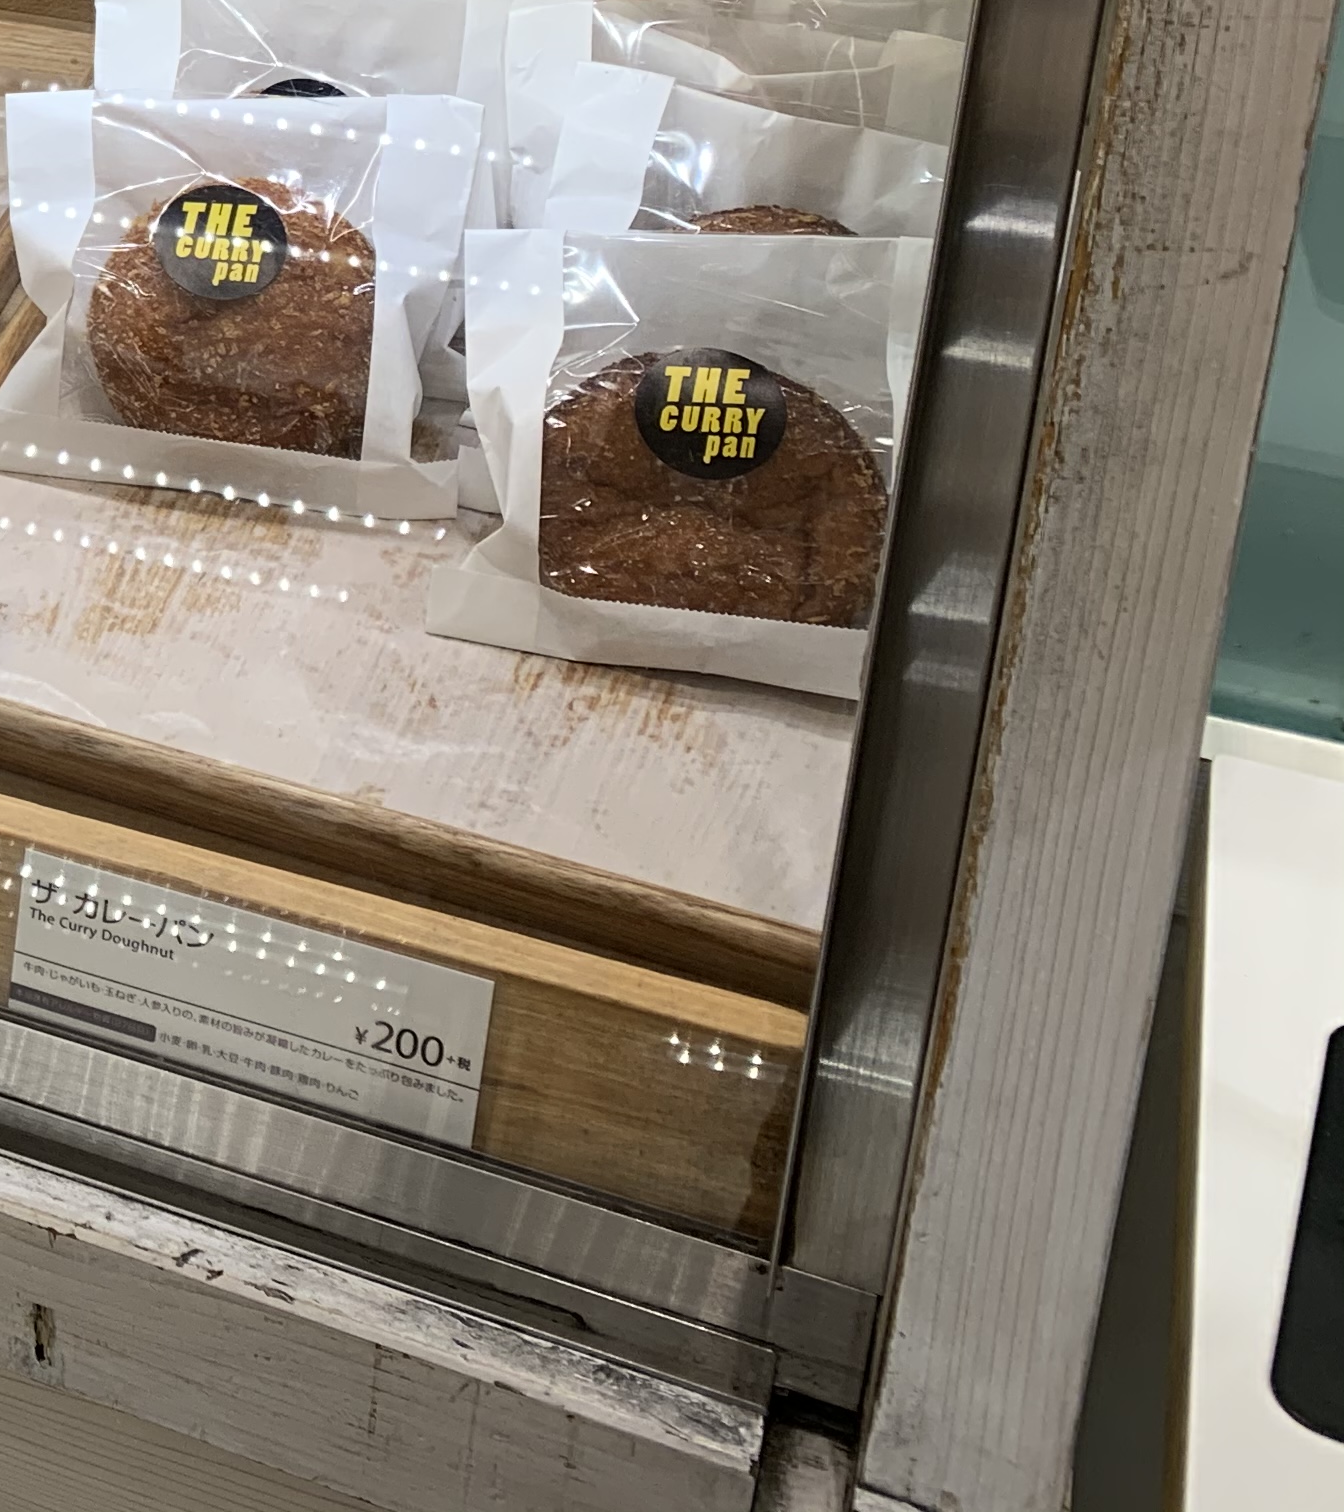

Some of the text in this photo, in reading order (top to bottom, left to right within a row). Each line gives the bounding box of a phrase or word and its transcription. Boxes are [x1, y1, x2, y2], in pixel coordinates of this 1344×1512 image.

[181, 201, 258, 238] THE
[175, 236, 266, 263] CURRY
[212, 262, 261, 287] pan
[664, 365, 751, 405] THE
[658, 405, 766, 435] CURRY
[702, 434, 757, 465] pan
[30, 878, 215, 948] ザカレーパン
[29, 905, 175, 961] The Curry Doughnut
[354, 1020, 472, 1072] ¥200+税
